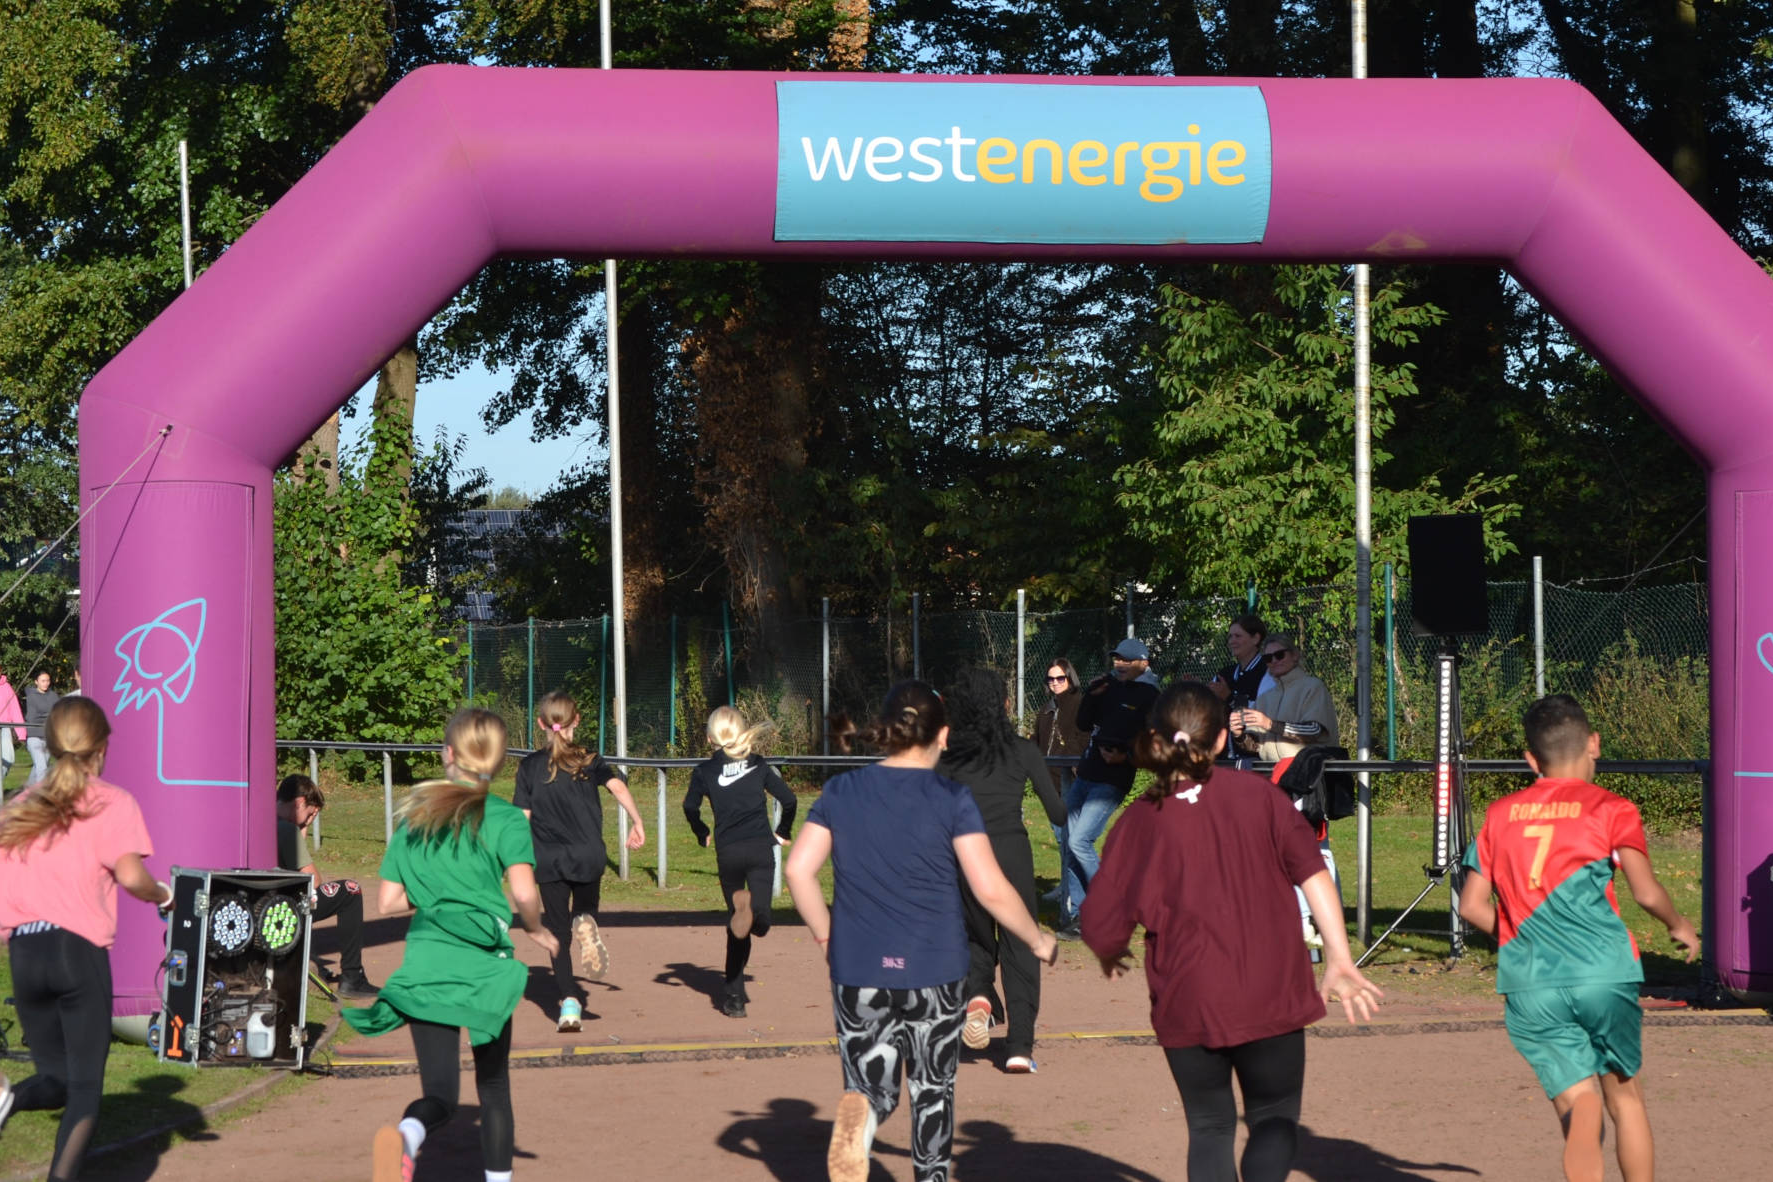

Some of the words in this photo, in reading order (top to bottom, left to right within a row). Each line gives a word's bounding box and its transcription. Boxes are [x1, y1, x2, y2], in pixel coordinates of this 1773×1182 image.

[801, 123, 1247, 203] westenergie
[723, 760, 748, 776] NIKE
[1509, 802, 1582, 822] RONALDO
[1523, 825, 1554, 891] 7
